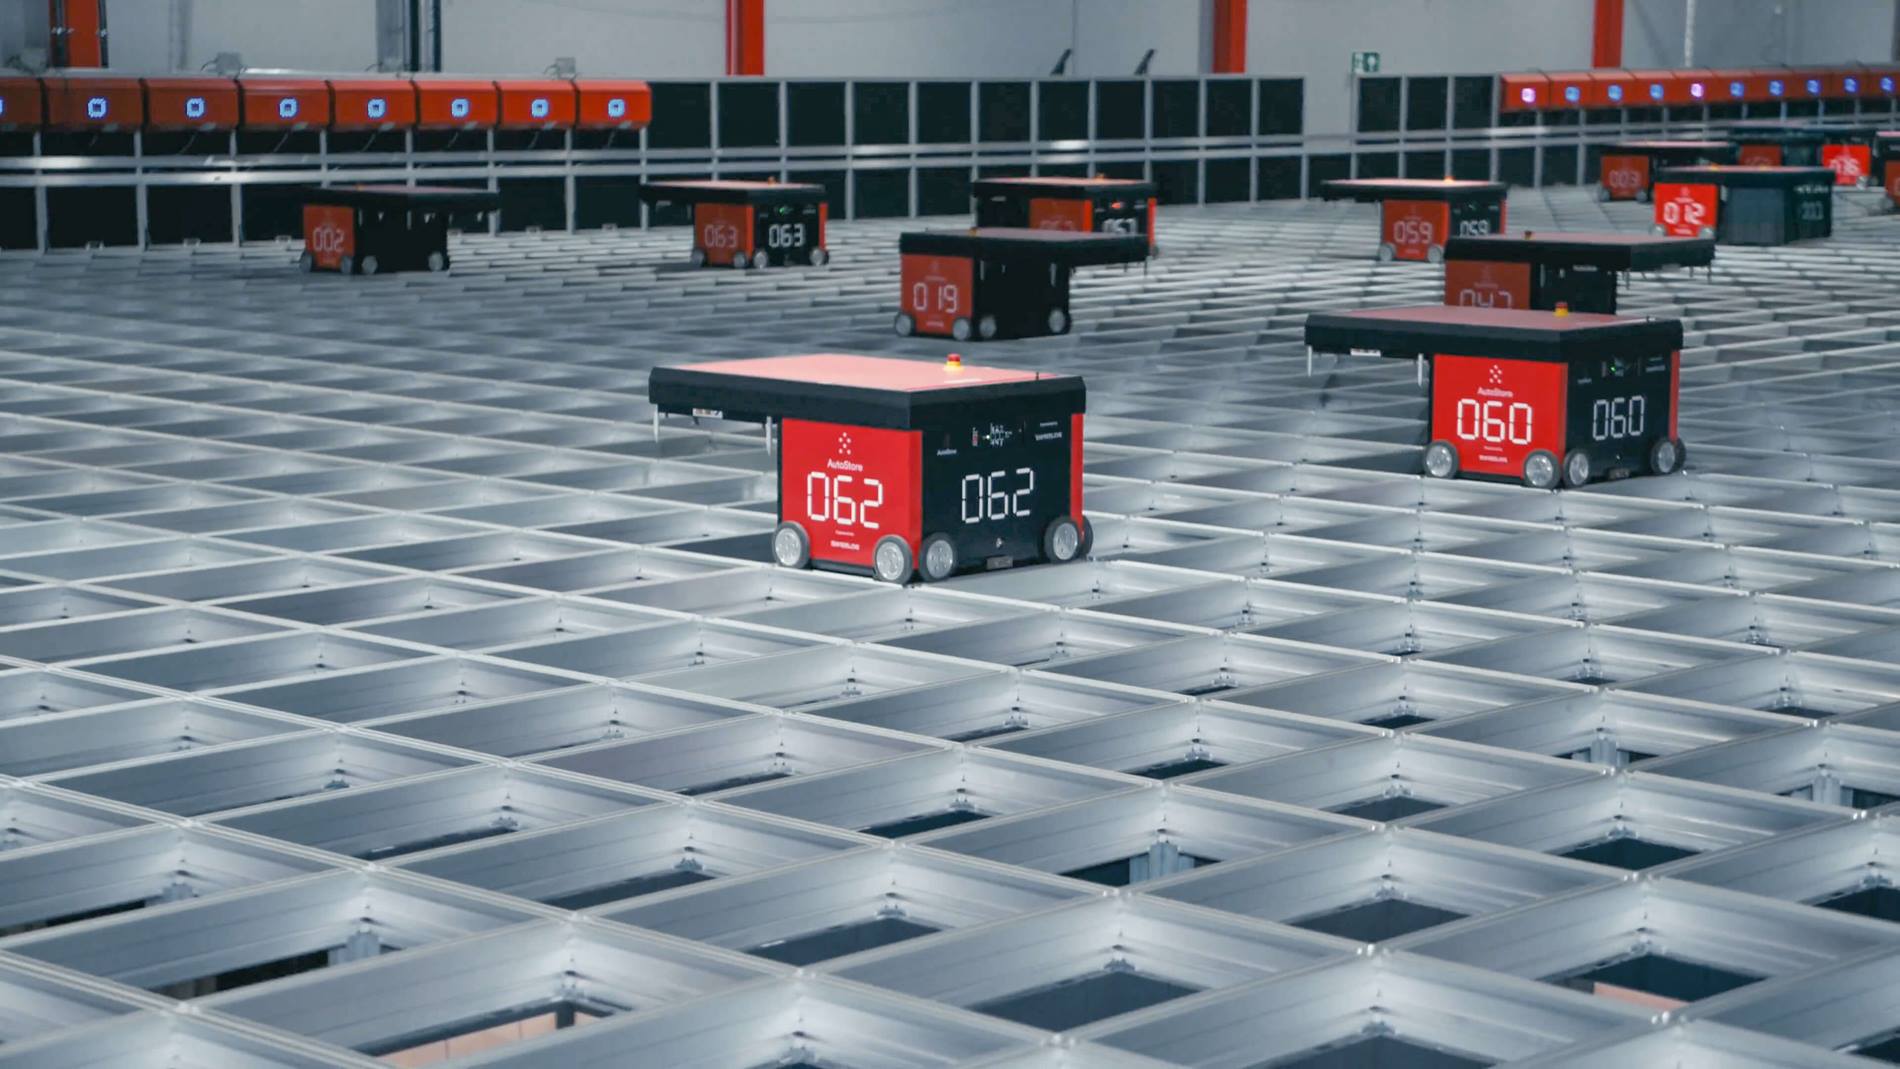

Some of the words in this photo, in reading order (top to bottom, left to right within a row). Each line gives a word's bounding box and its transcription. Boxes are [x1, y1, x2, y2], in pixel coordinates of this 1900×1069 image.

[1663, 202, 1705, 225] 012
[313, 227, 345, 251] 002
[704, 224, 739, 248] 063
[768, 223, 806, 248] 063
[1393, 220, 1433, 244] 059
[913, 281, 959, 314] 019
[1457, 398, 1532, 445] 060
[1592, 395, 1645, 441] 060
[827, 458, 863, 473] AutoStore
[807, 471, 883, 530] 062
[961, 467, 1034, 524] 062
